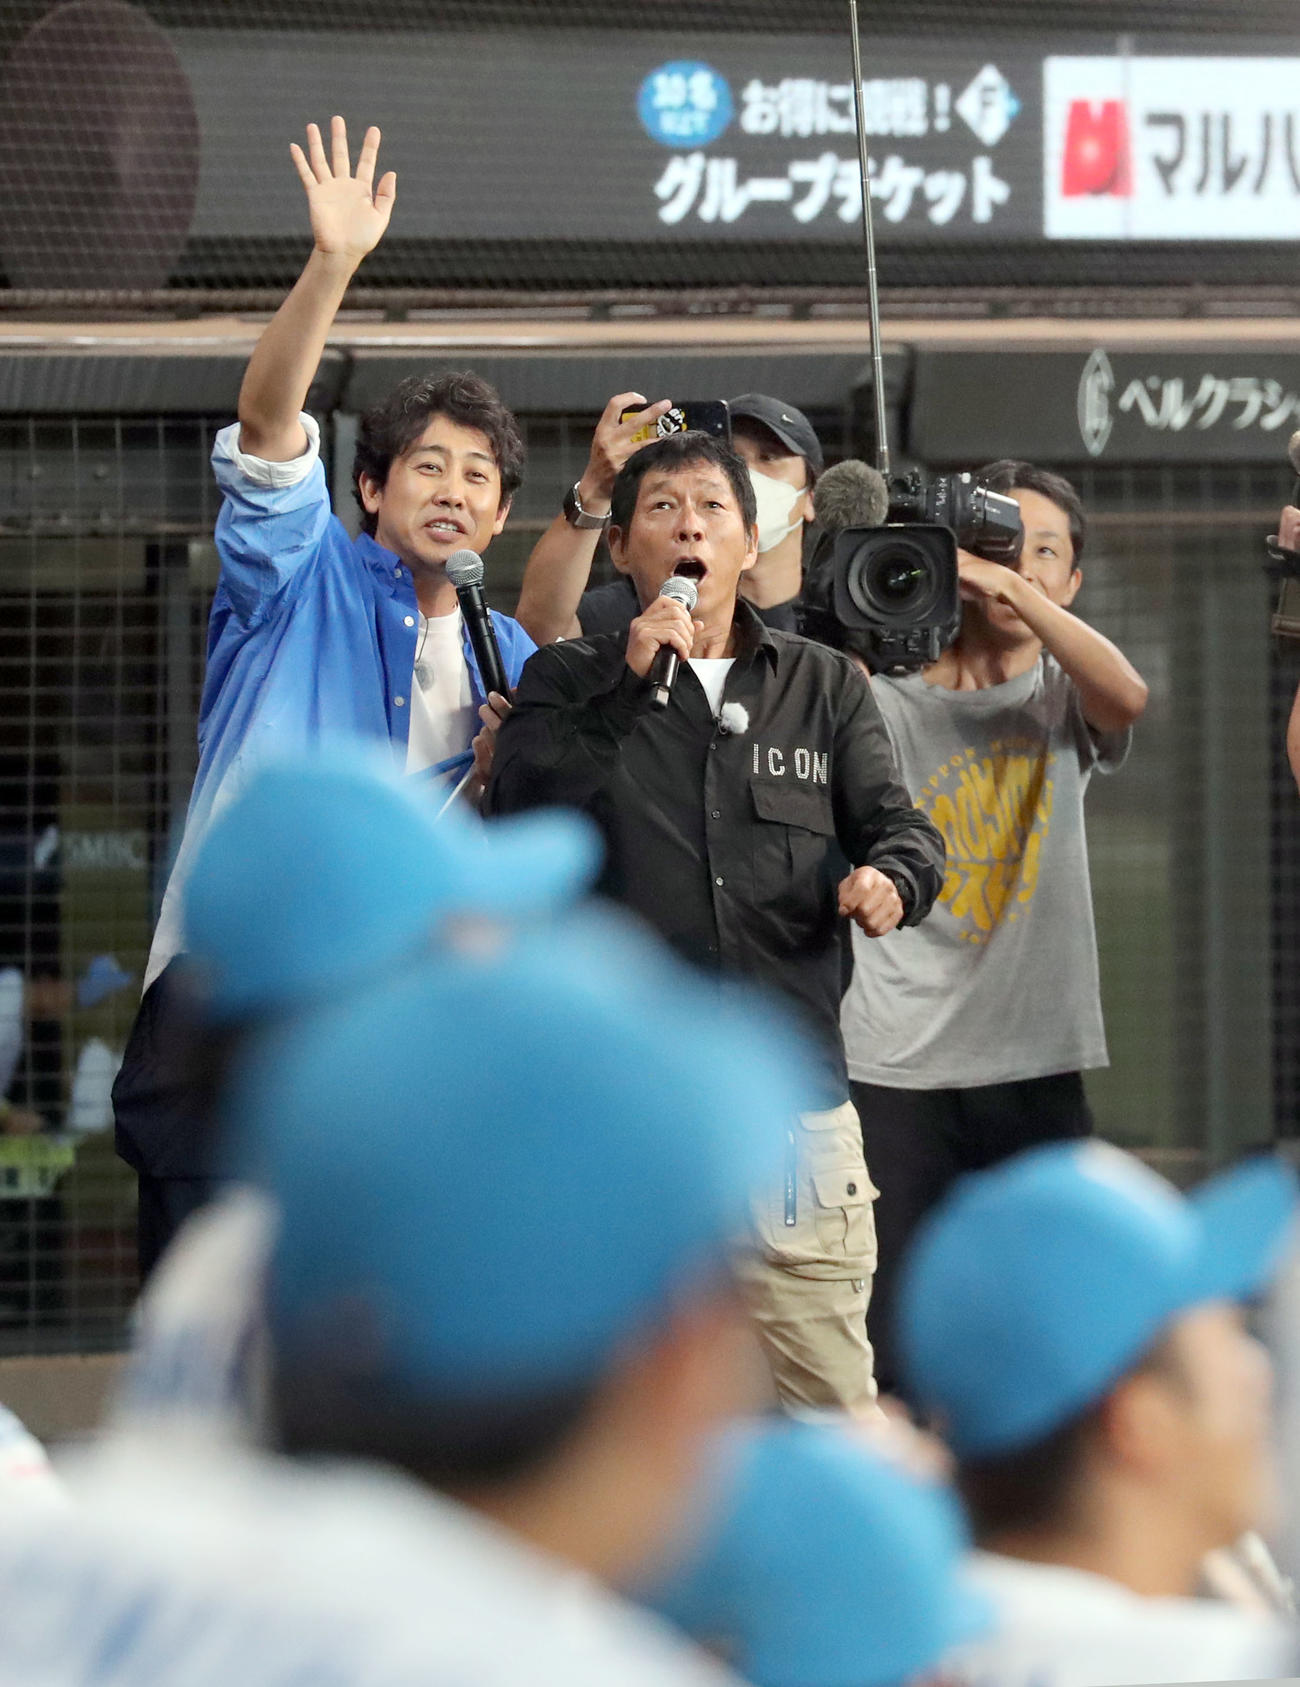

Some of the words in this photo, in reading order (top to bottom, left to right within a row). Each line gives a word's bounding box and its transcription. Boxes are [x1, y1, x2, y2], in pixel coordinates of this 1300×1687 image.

[654, 152, 1011, 225] グループチケット
[1118, 373, 1300, 431] ベルクラシ
[753, 743, 828, 784] ICON
